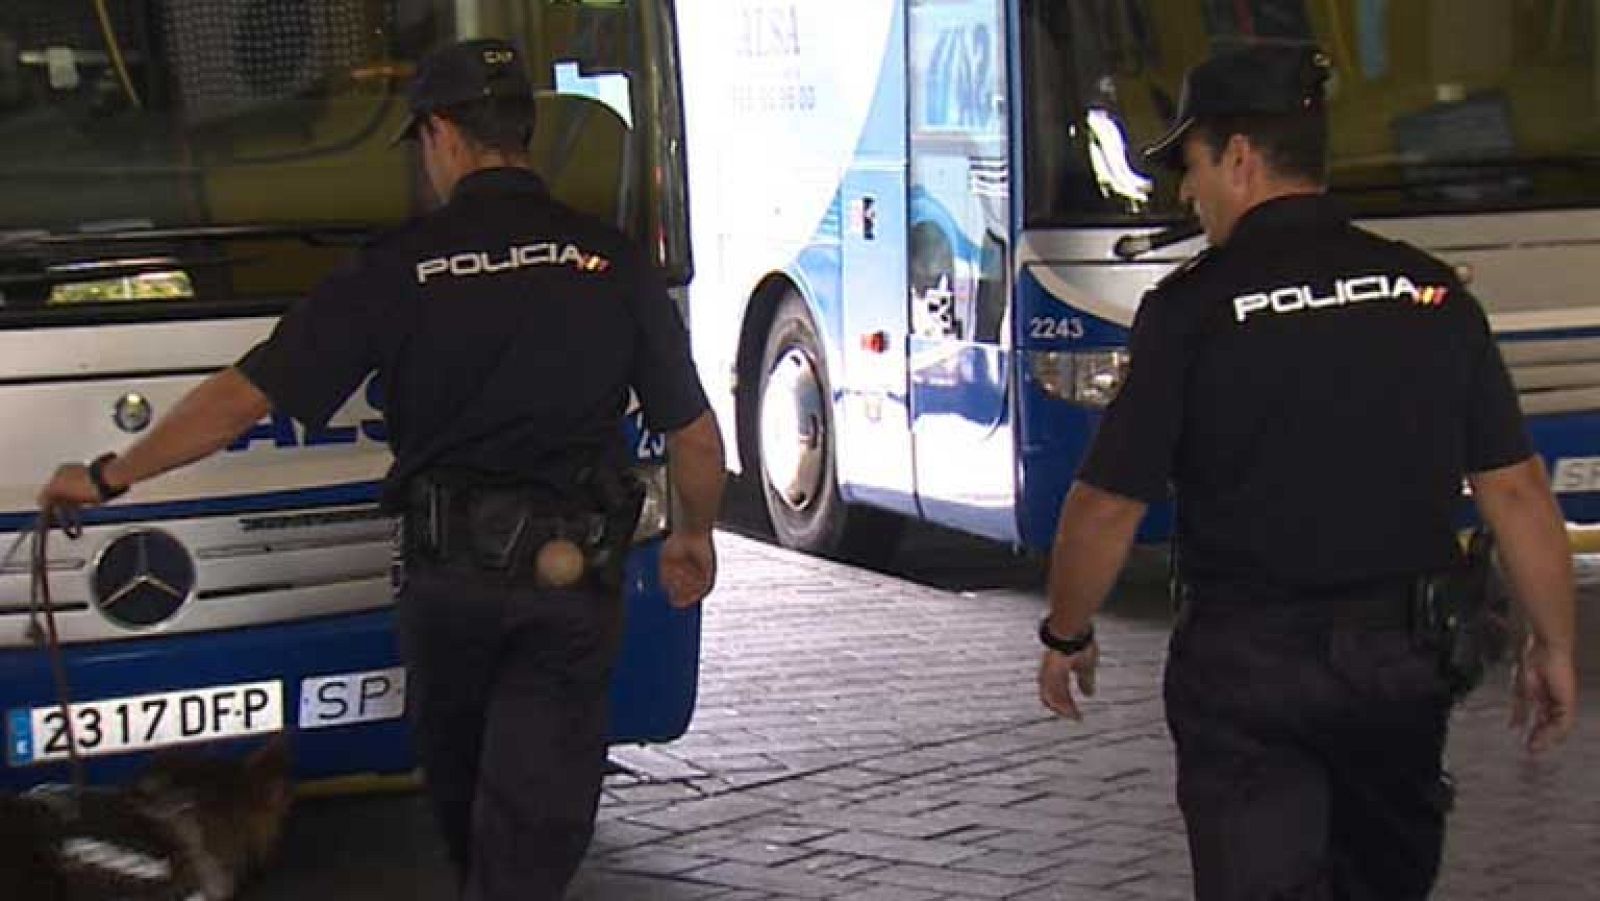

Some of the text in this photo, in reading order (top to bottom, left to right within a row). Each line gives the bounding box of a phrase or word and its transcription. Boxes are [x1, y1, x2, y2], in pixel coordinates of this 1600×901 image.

[416, 243, 582, 284] POLICIA
[1233, 274, 1420, 322] POLICIA
[1030, 316, 1083, 339] 2243
[317, 676, 391, 720] SP
[43, 700, 168, 755] 2317
